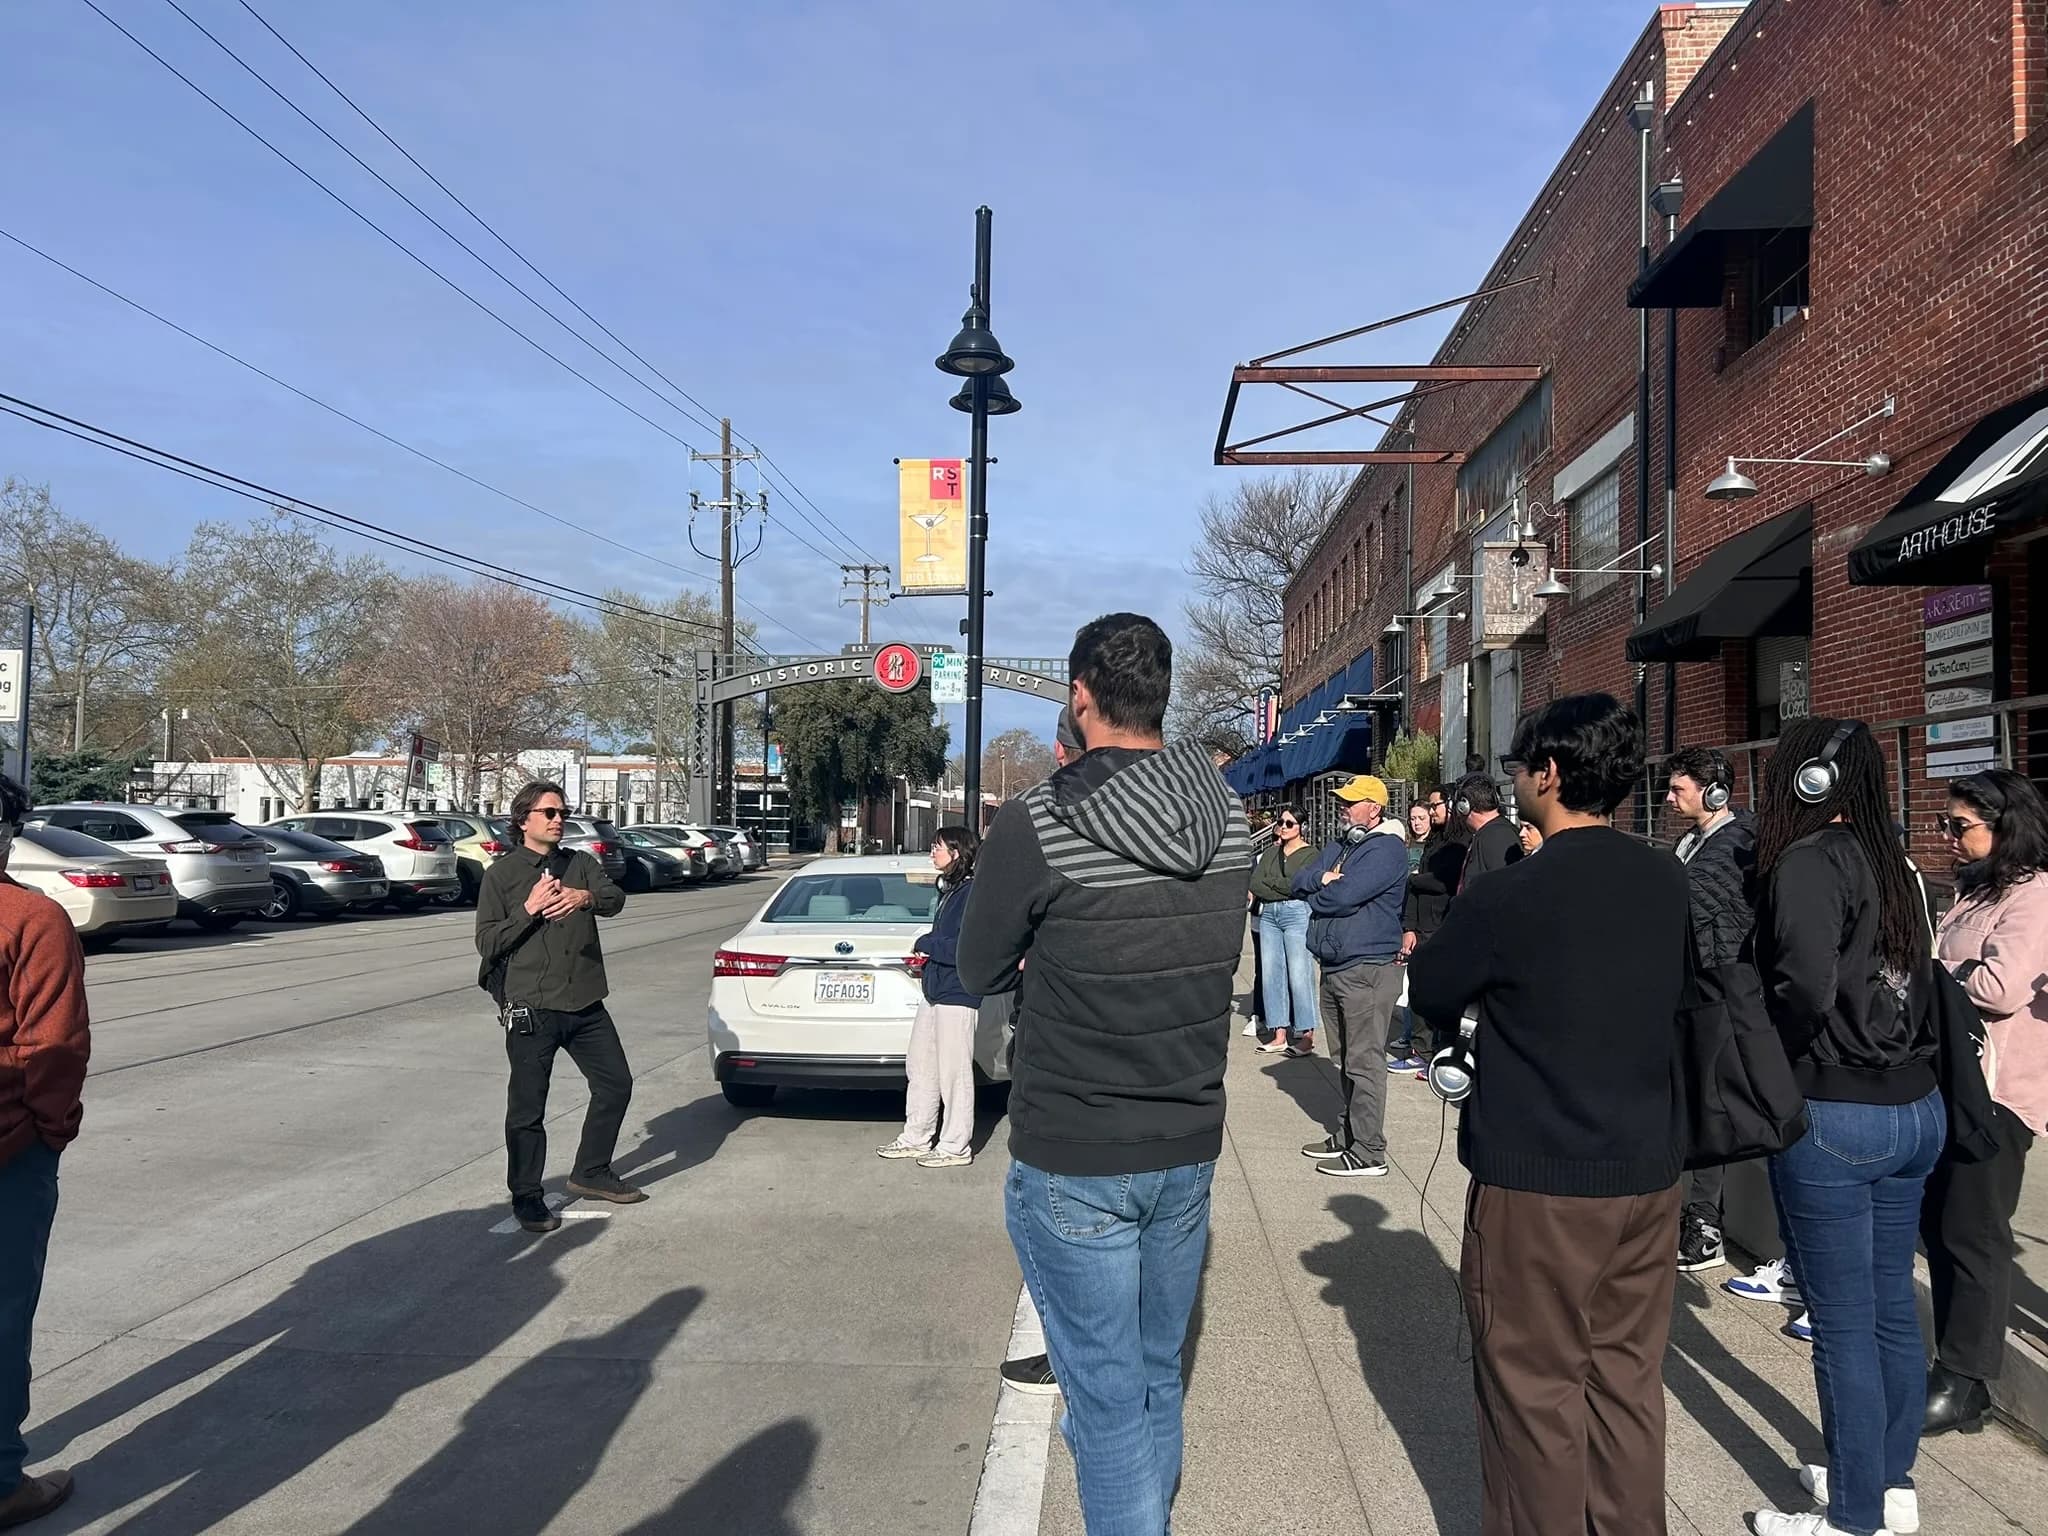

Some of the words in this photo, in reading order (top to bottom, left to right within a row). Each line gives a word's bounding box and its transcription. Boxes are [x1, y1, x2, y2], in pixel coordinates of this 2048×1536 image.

[1898, 502, 1998, 562] ARTHOUSE
[934, 656, 945, 667] 90
[946, 657, 963, 667] MIN
[750, 659, 863, 686] HISTORIC
[934, 670, 962, 680] PARKING
[820, 984, 869, 998] 7GFA035
